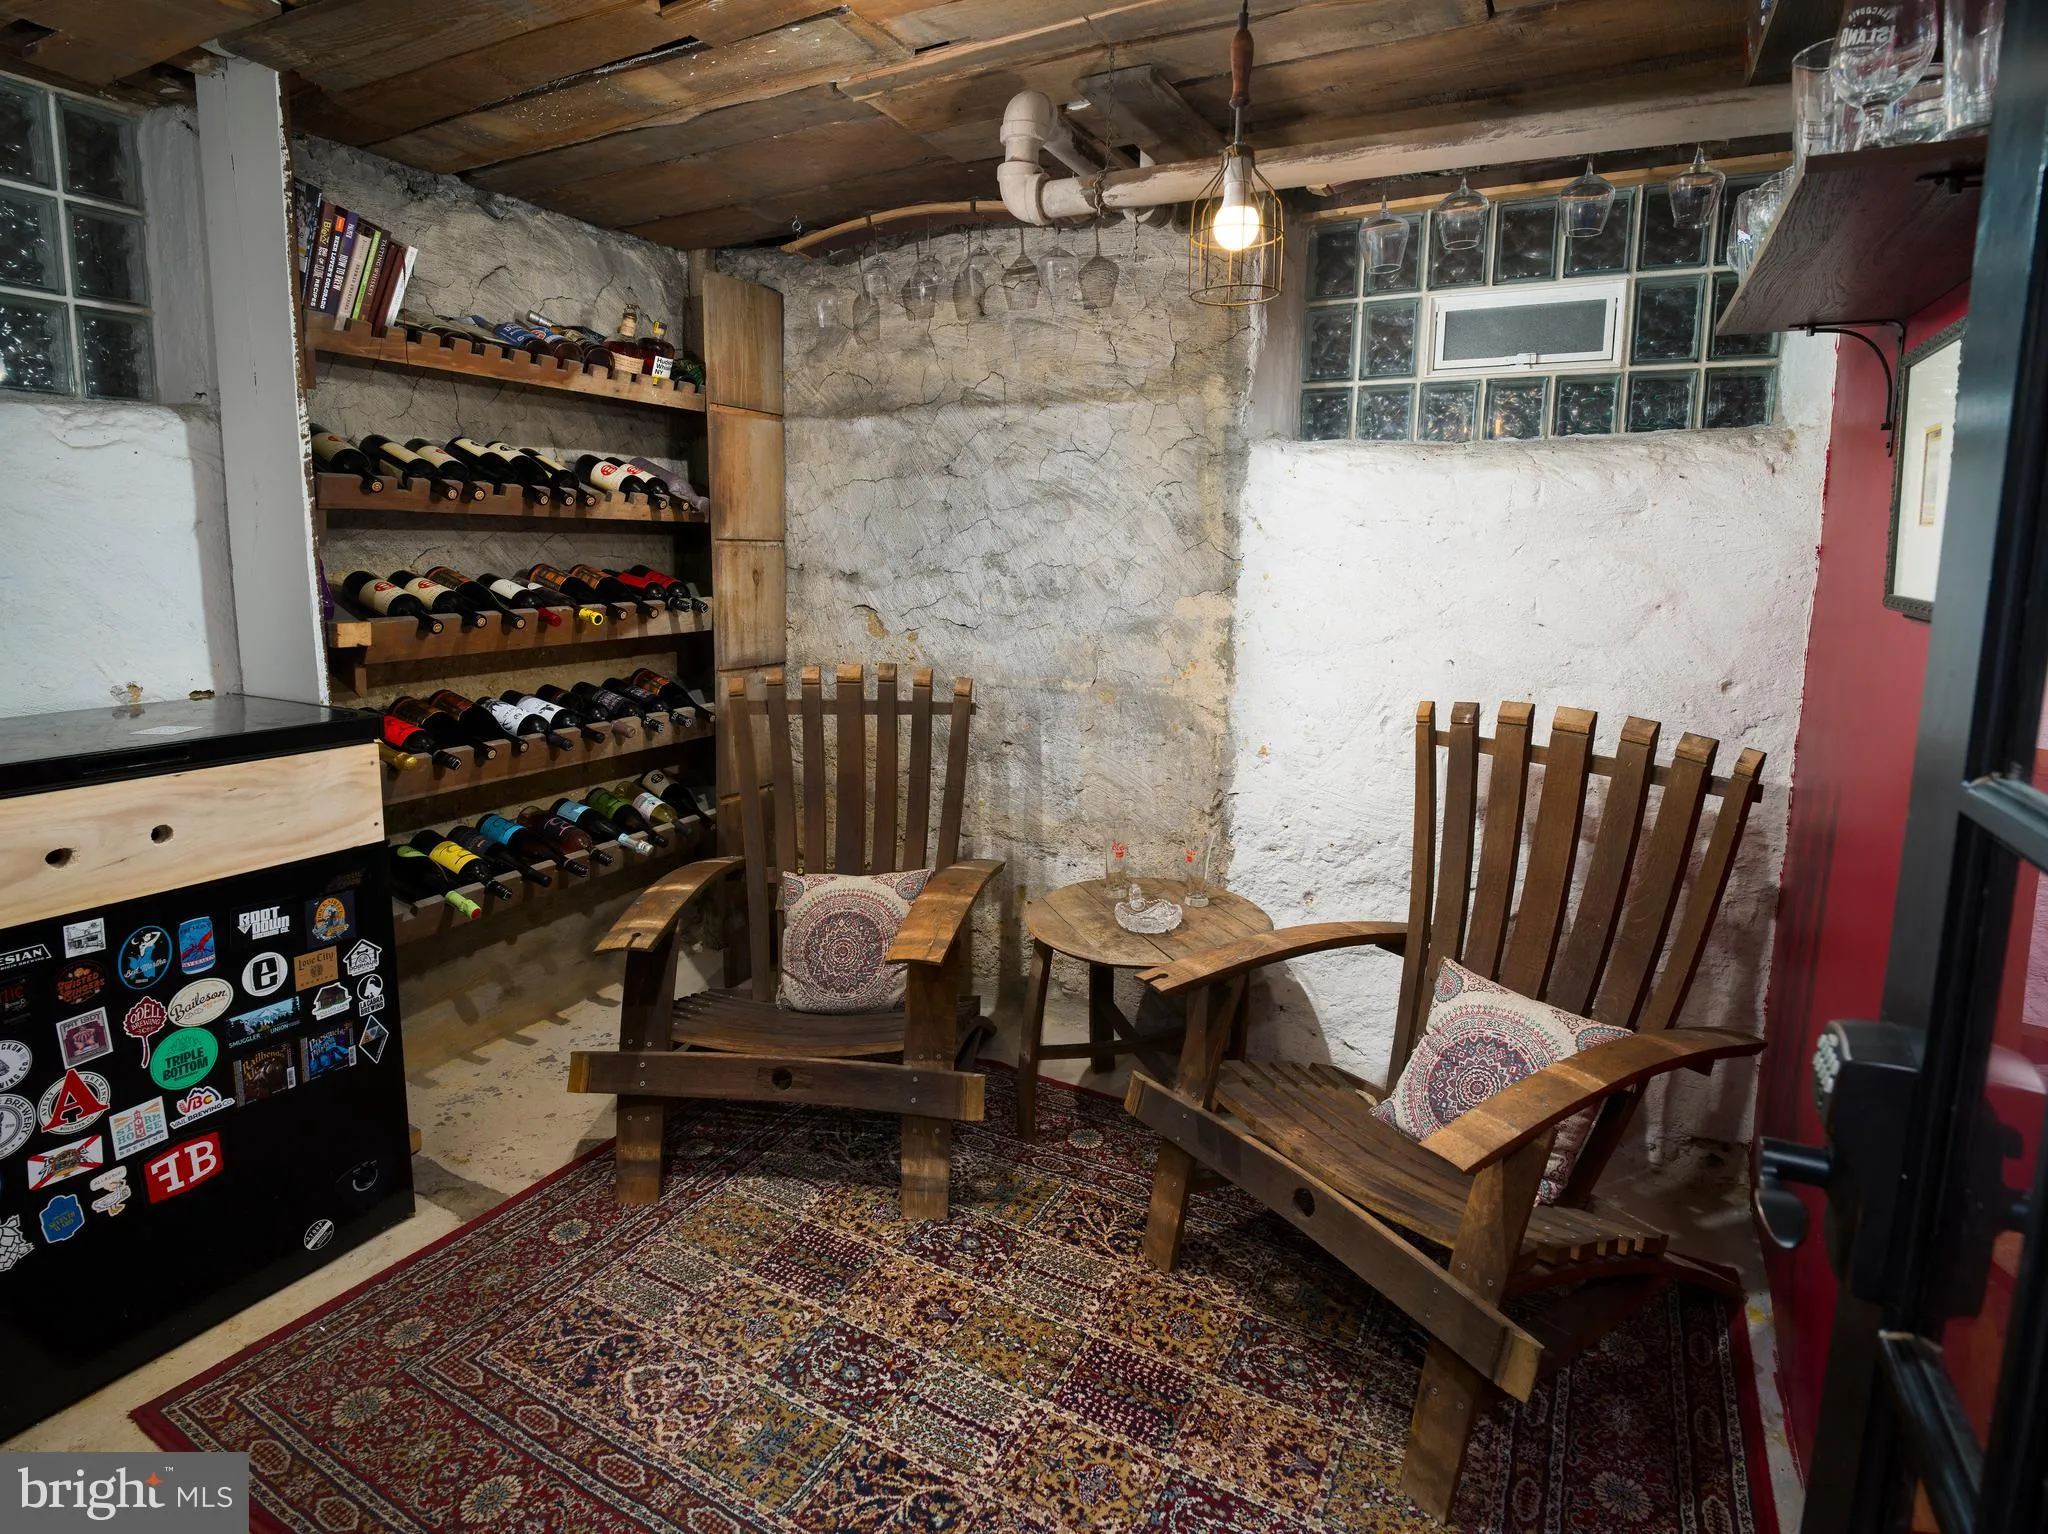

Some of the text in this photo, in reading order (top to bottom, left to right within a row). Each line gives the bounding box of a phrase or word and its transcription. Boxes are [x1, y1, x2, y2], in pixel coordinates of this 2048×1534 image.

[338, 254, 349, 269] HOW
[375, 239, 388, 271] TASTING
[320, 235, 341, 309] BEER LOVER'S COLORADO
[333, 274, 344, 291] BREW
[368, 271, 381, 297] WHISKEY
[310, 278, 320, 307] RECIPES
[239, 905, 280, 930] ROOT
[252, 915, 290, 934] DOWN
[316, 951, 334, 962] City
[130, 1003, 161, 1024] ODELL
[169, 990, 226, 1022] Baileson
[131, 1018, 161, 1030] BREWING
[229, 1033, 261, 1049] SMUGGLER
[270, 1023, 289, 1034] UNION
[163, 1056, 209, 1081] BOTTOM
[165, 1047, 204, 1068] TRIPLE
[41, 1068, 110, 1133] A
[41, 1092, 54, 1116] AVERY
[4, 1098, 31, 1135] BREWERY
[171, 1118, 187, 1128] VAIL
[188, 1102, 222, 1121] BREWING
